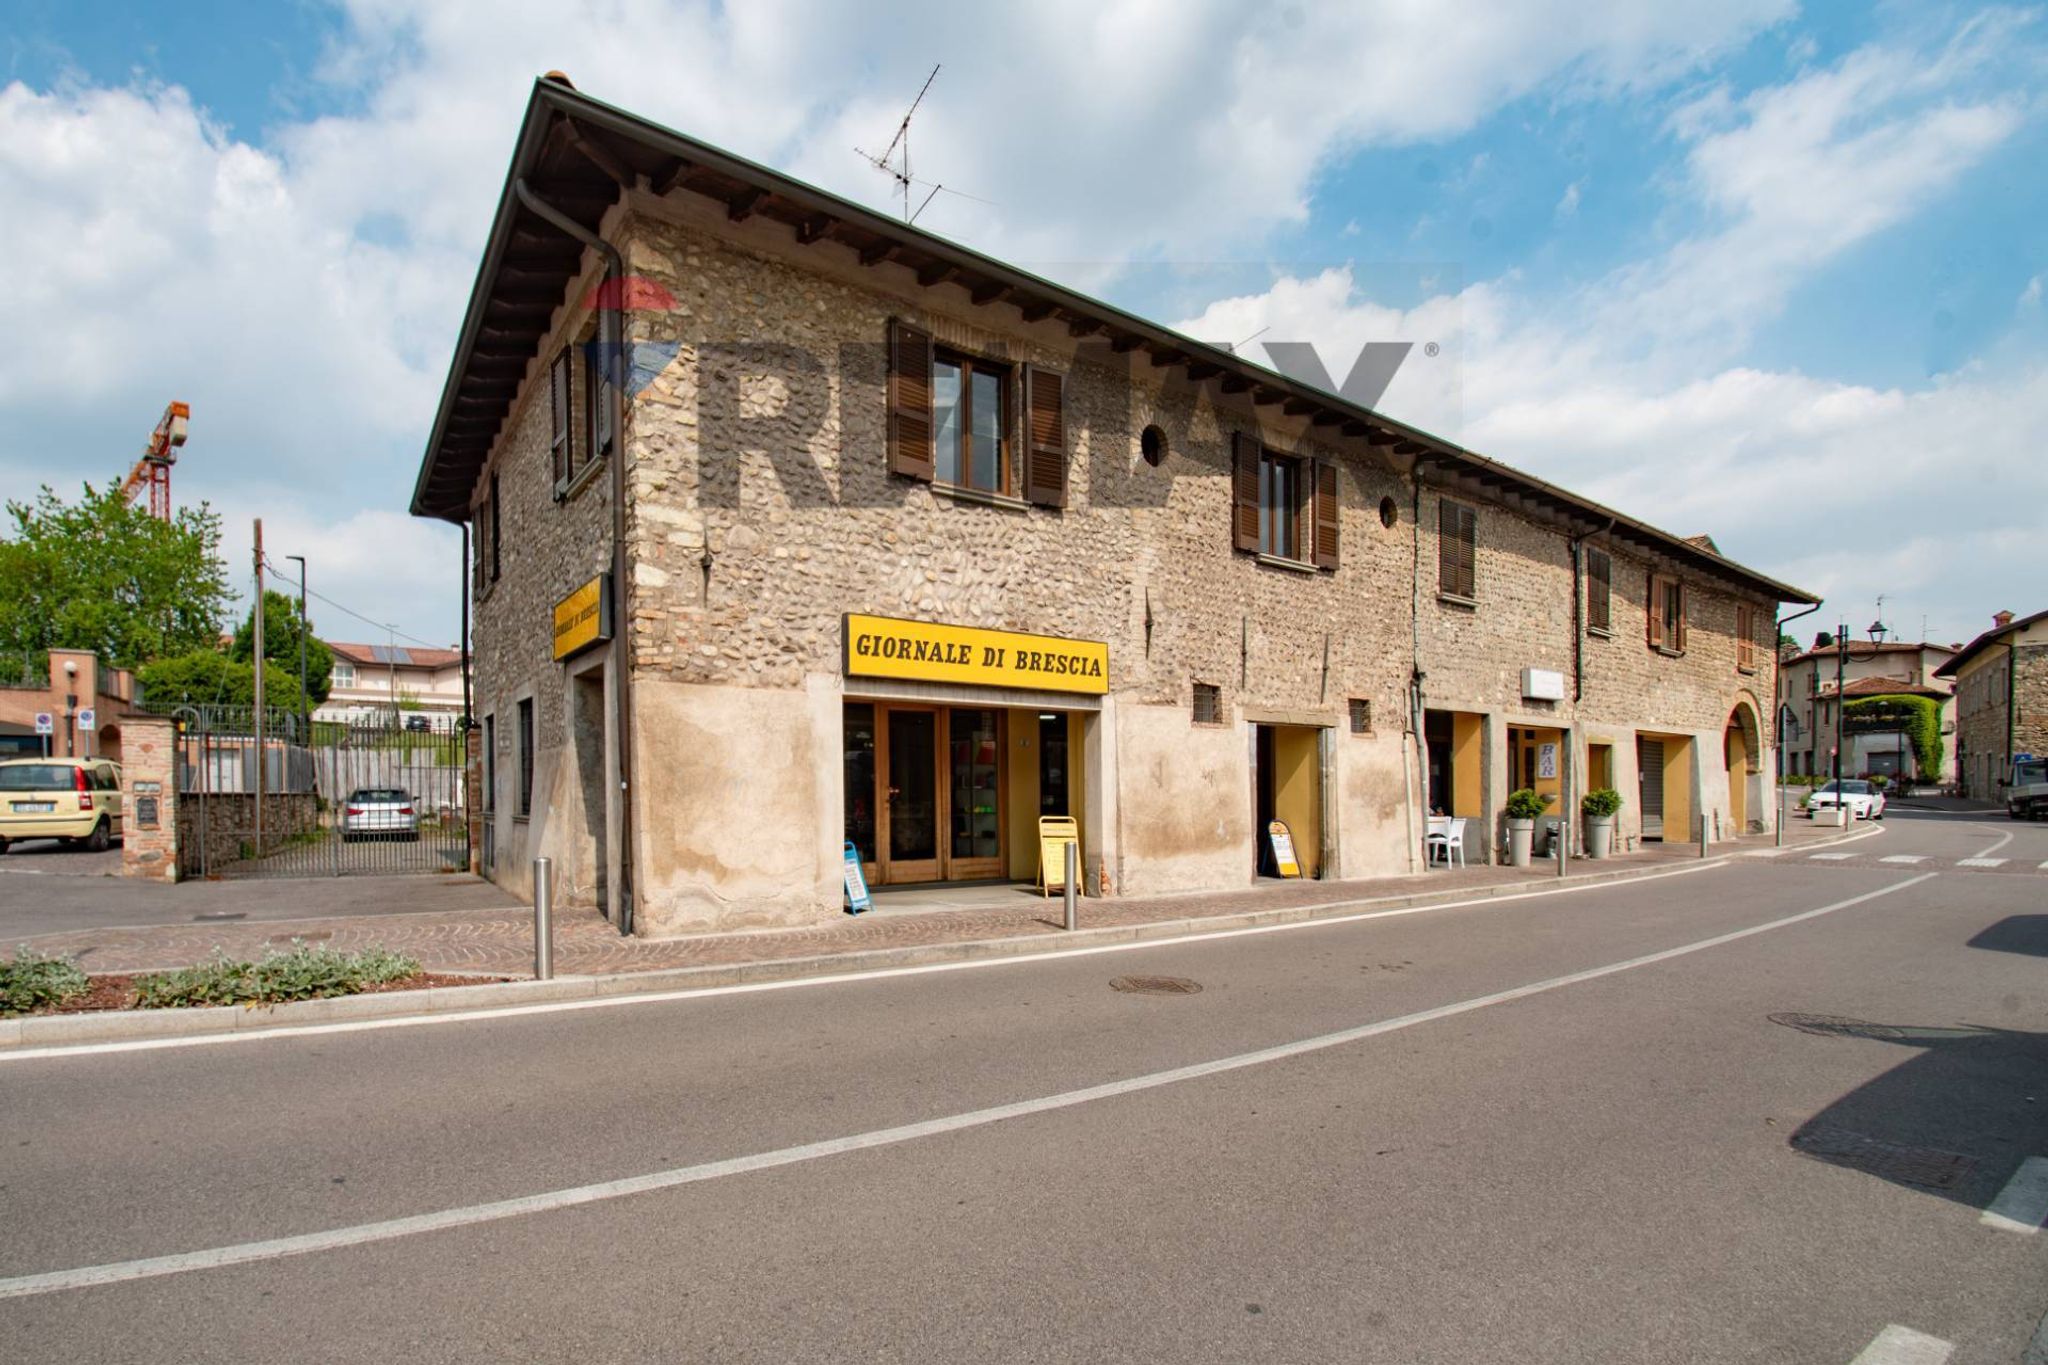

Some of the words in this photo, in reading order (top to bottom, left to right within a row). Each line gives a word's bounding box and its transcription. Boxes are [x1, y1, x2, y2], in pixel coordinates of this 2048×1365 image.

[856, 634, 972, 665] GIORNALE
[982, 647, 1005, 668] DI
[1015, 650, 1102, 677] BRESCIA
[1541, 744, 1554, 776] BAR
